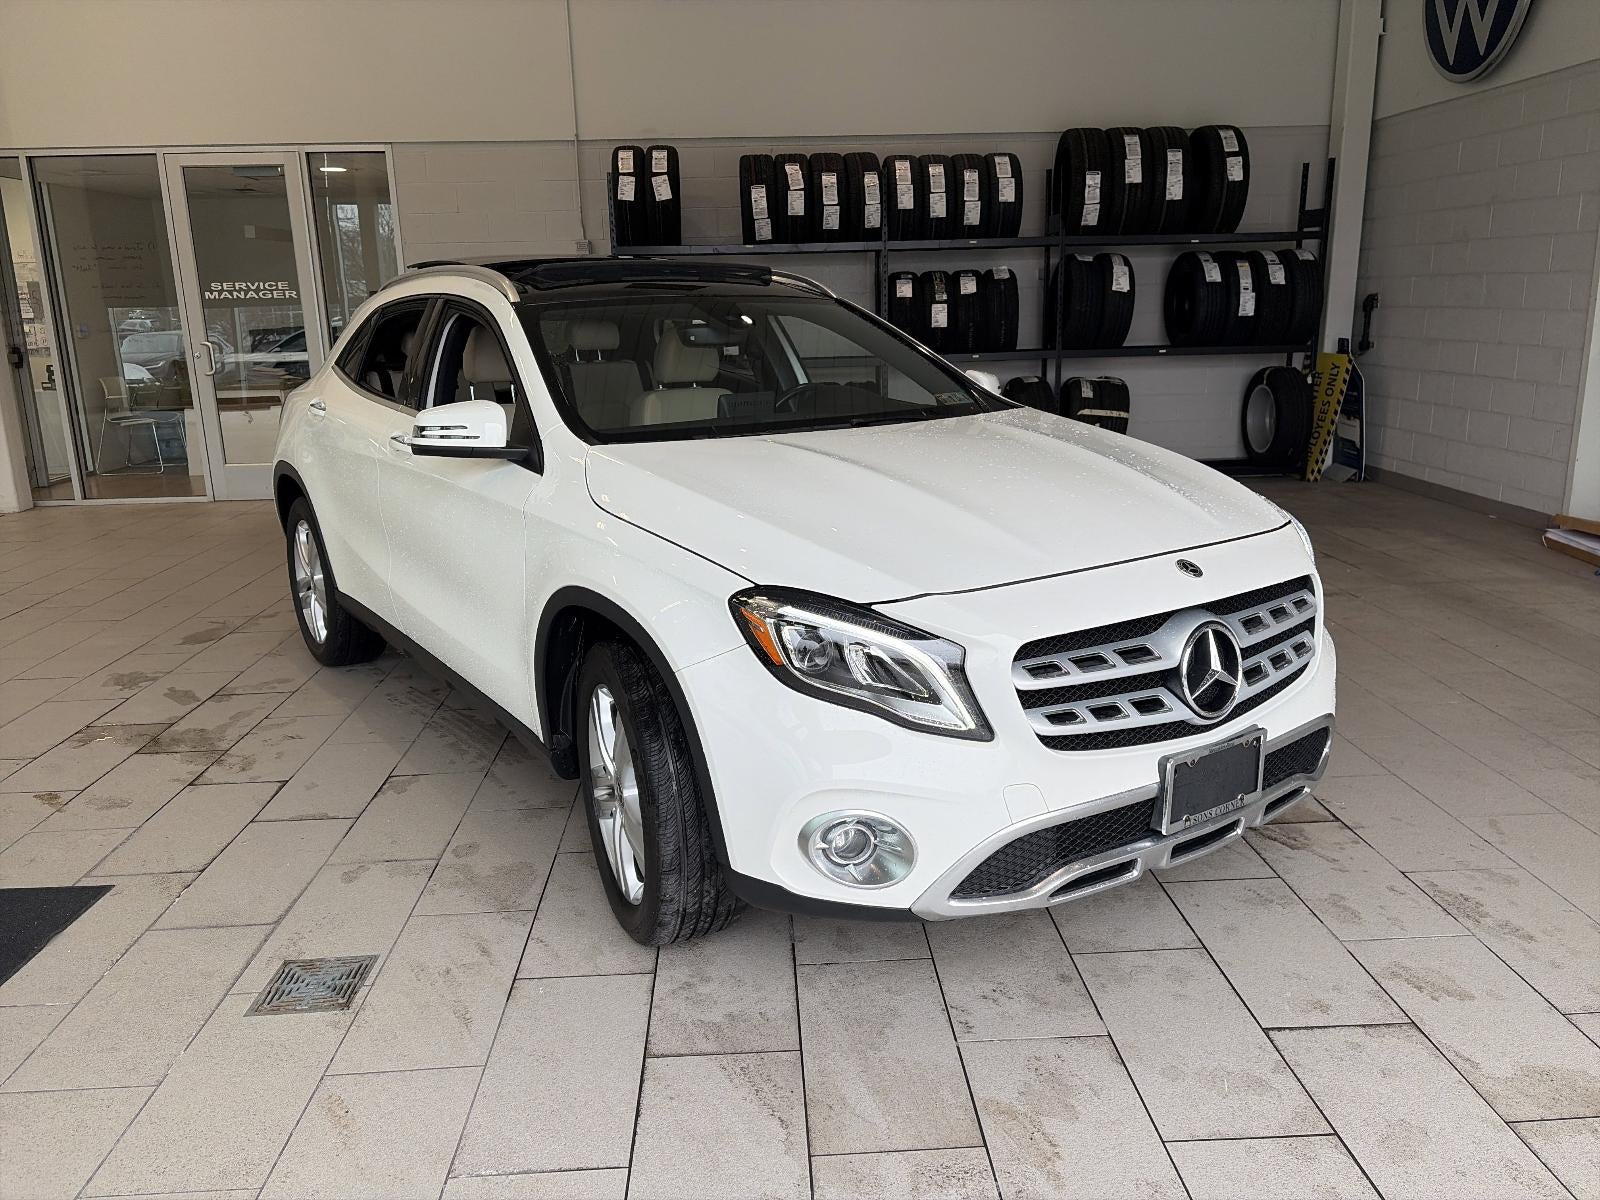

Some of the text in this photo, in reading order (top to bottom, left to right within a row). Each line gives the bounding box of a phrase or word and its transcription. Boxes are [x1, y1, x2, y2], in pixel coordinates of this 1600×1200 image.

[210, 281, 290, 291] SERVICE
[204, 290, 298, 300] MANAGER
[1324, 362, 1341, 397] ONLY
